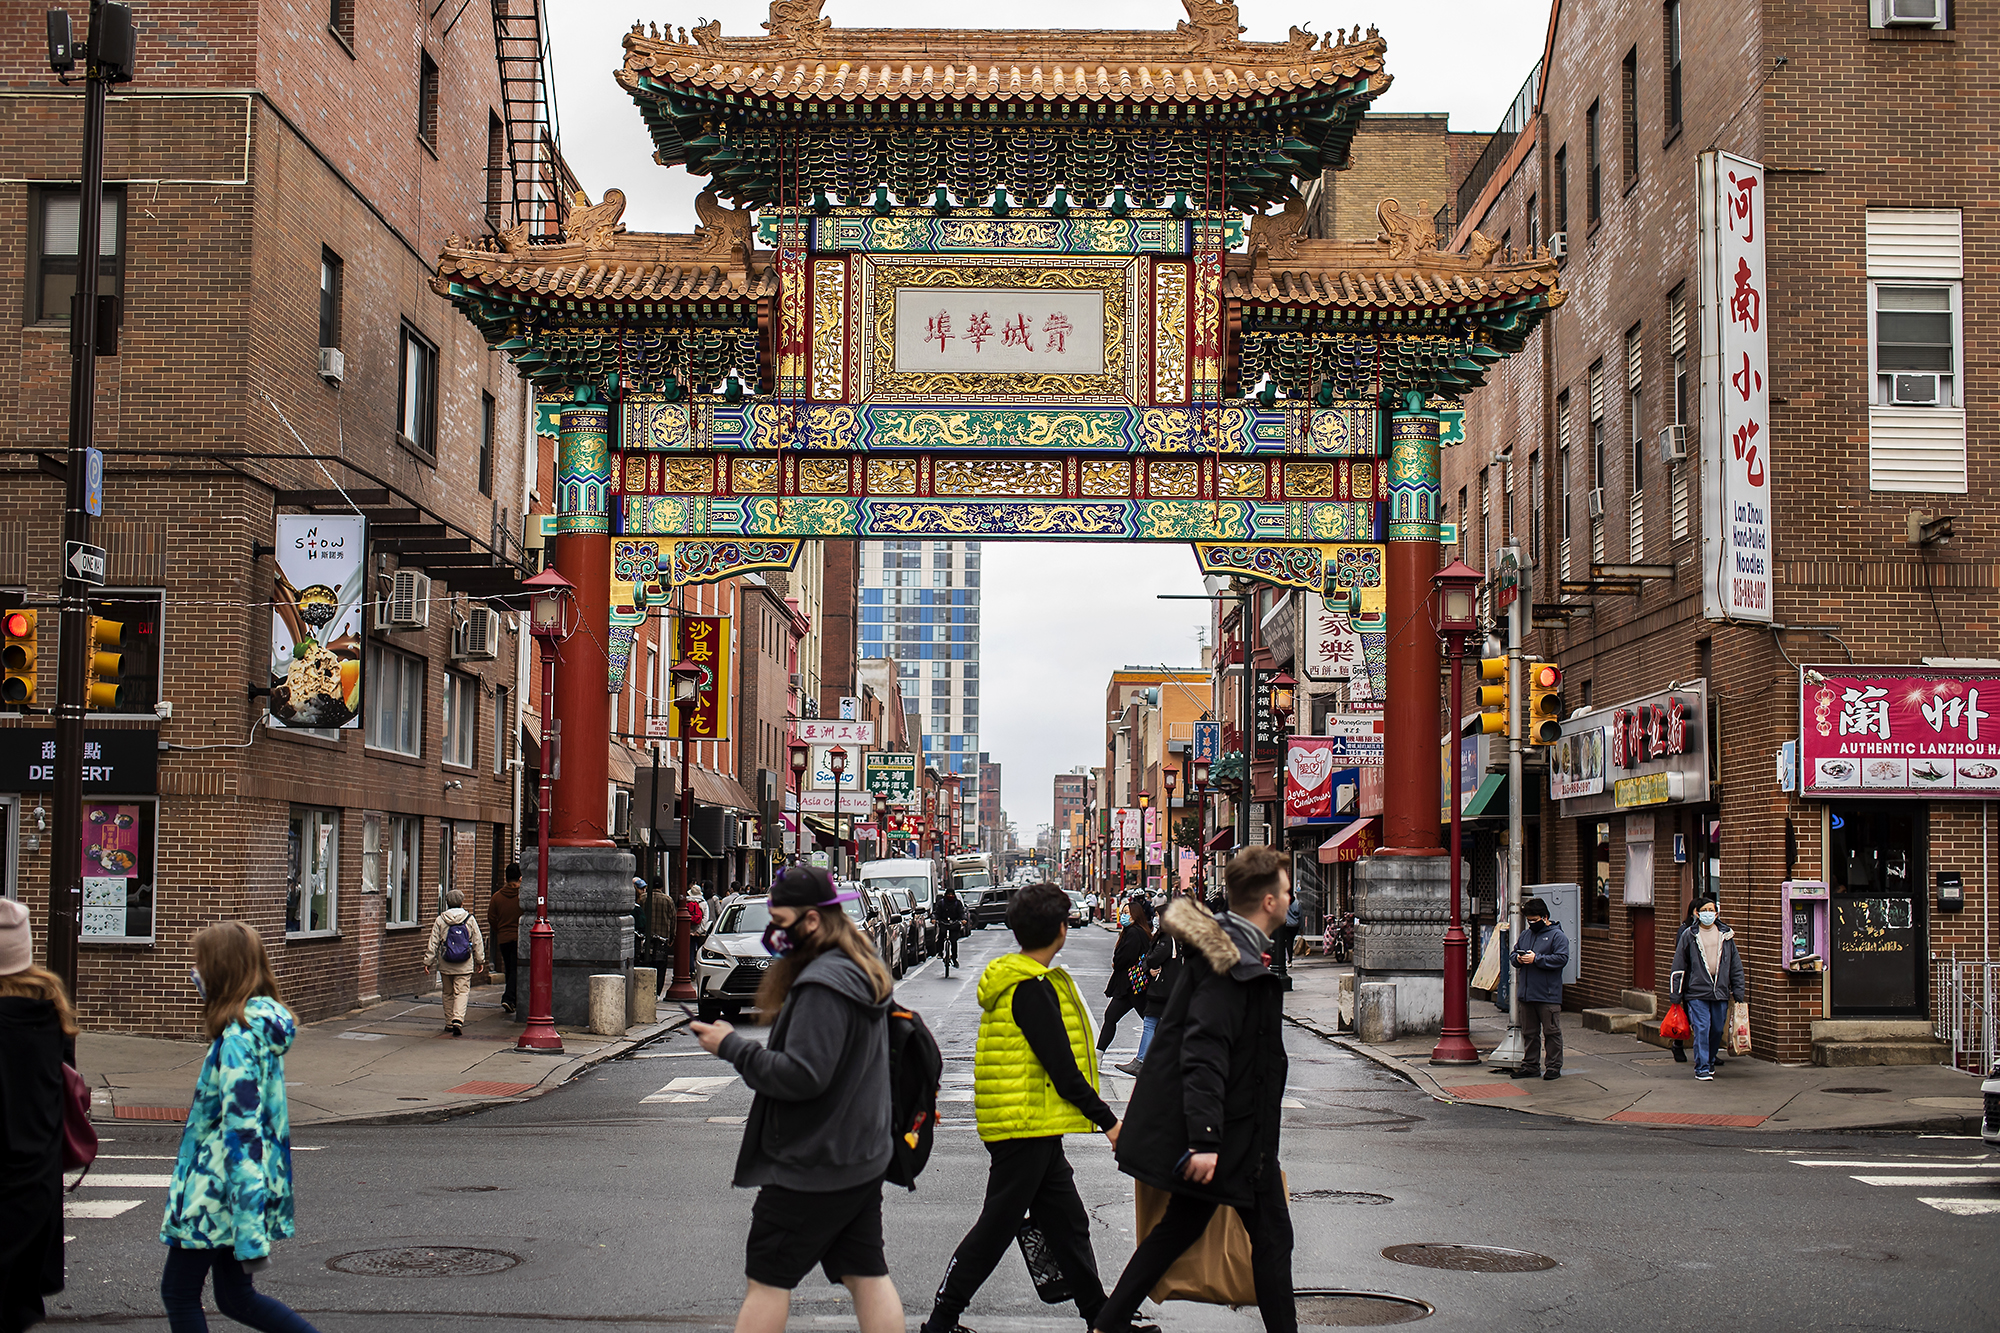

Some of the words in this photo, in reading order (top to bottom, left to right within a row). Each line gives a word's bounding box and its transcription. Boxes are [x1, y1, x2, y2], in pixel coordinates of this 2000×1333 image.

[1727, 170, 1766, 488] 河南小吃
[92, 462, 98, 480] P
[82, 555, 94, 571] ONE
[1735, 551, 1765, 576] Noodles
[138, 622, 154, 635] EXIT
[1338, 719, 1372, 727] MoneyGram
[1839, 742, 1916, 755] AUTHENTIC
[1919, 742, 1985, 755] LANZHOU
[869, 756, 885, 765] TAI
[887, 756, 913, 765] LAKE
[29, 765, 114, 781] DEERT
[801, 796, 820, 807] Asia
[823, 797, 851, 809] Crfts
[853, 799, 870, 807] Inc.
[1340, 848, 1357, 861] SIU
